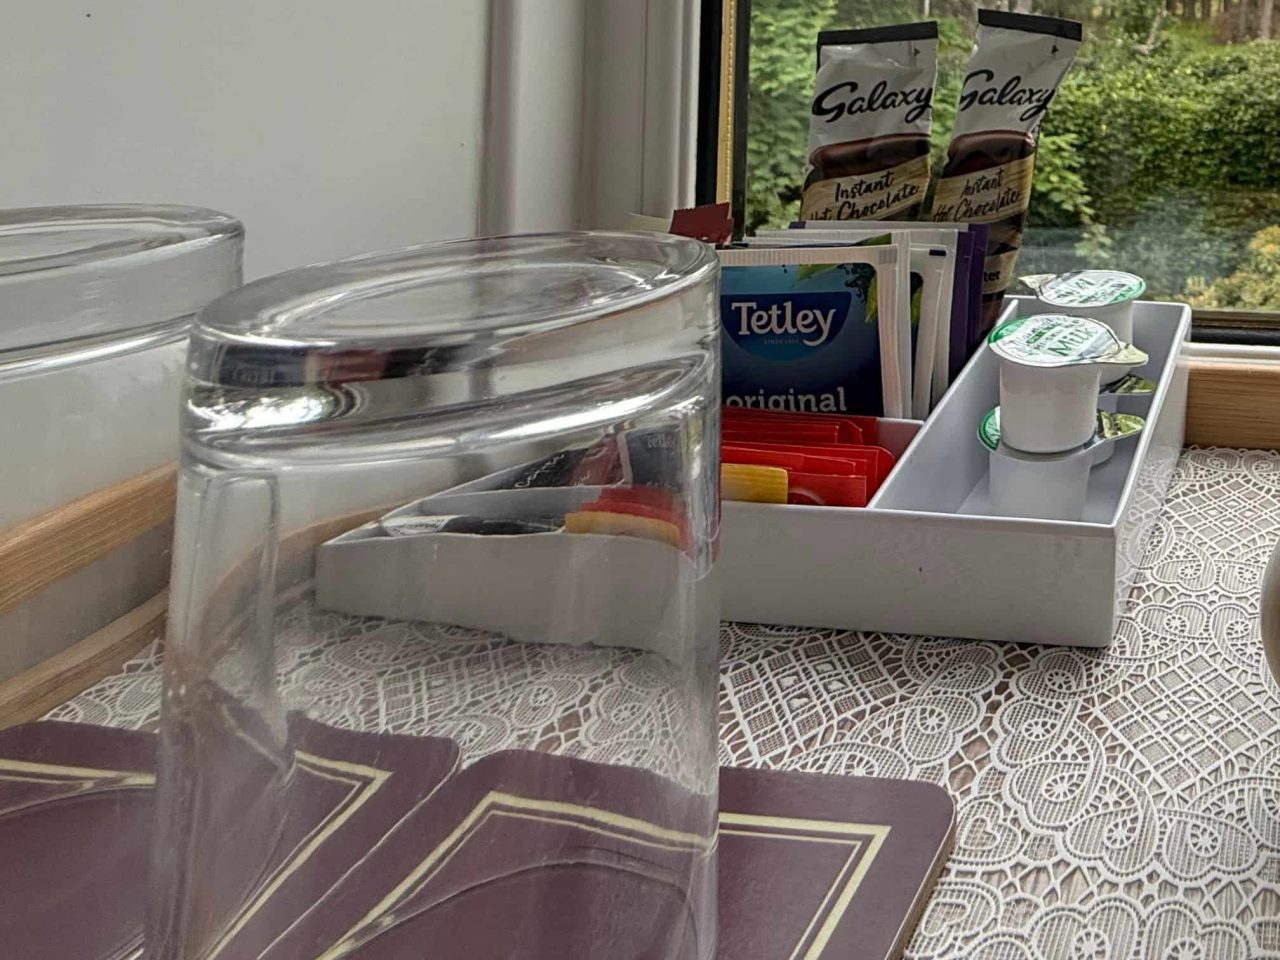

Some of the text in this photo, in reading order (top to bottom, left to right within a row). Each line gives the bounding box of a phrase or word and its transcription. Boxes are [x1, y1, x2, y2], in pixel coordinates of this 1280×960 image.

[811, 80, 933, 124] Galaxy
[835, 171, 895, 203] Instant
[960, 167, 1005, 198] Instant
[836, 184, 921, 221] Chocolate
[954, 188, 1022, 220] Chocolate
[983, 270, 1001, 282] ter
[731, 301, 837, 347] Tetley
